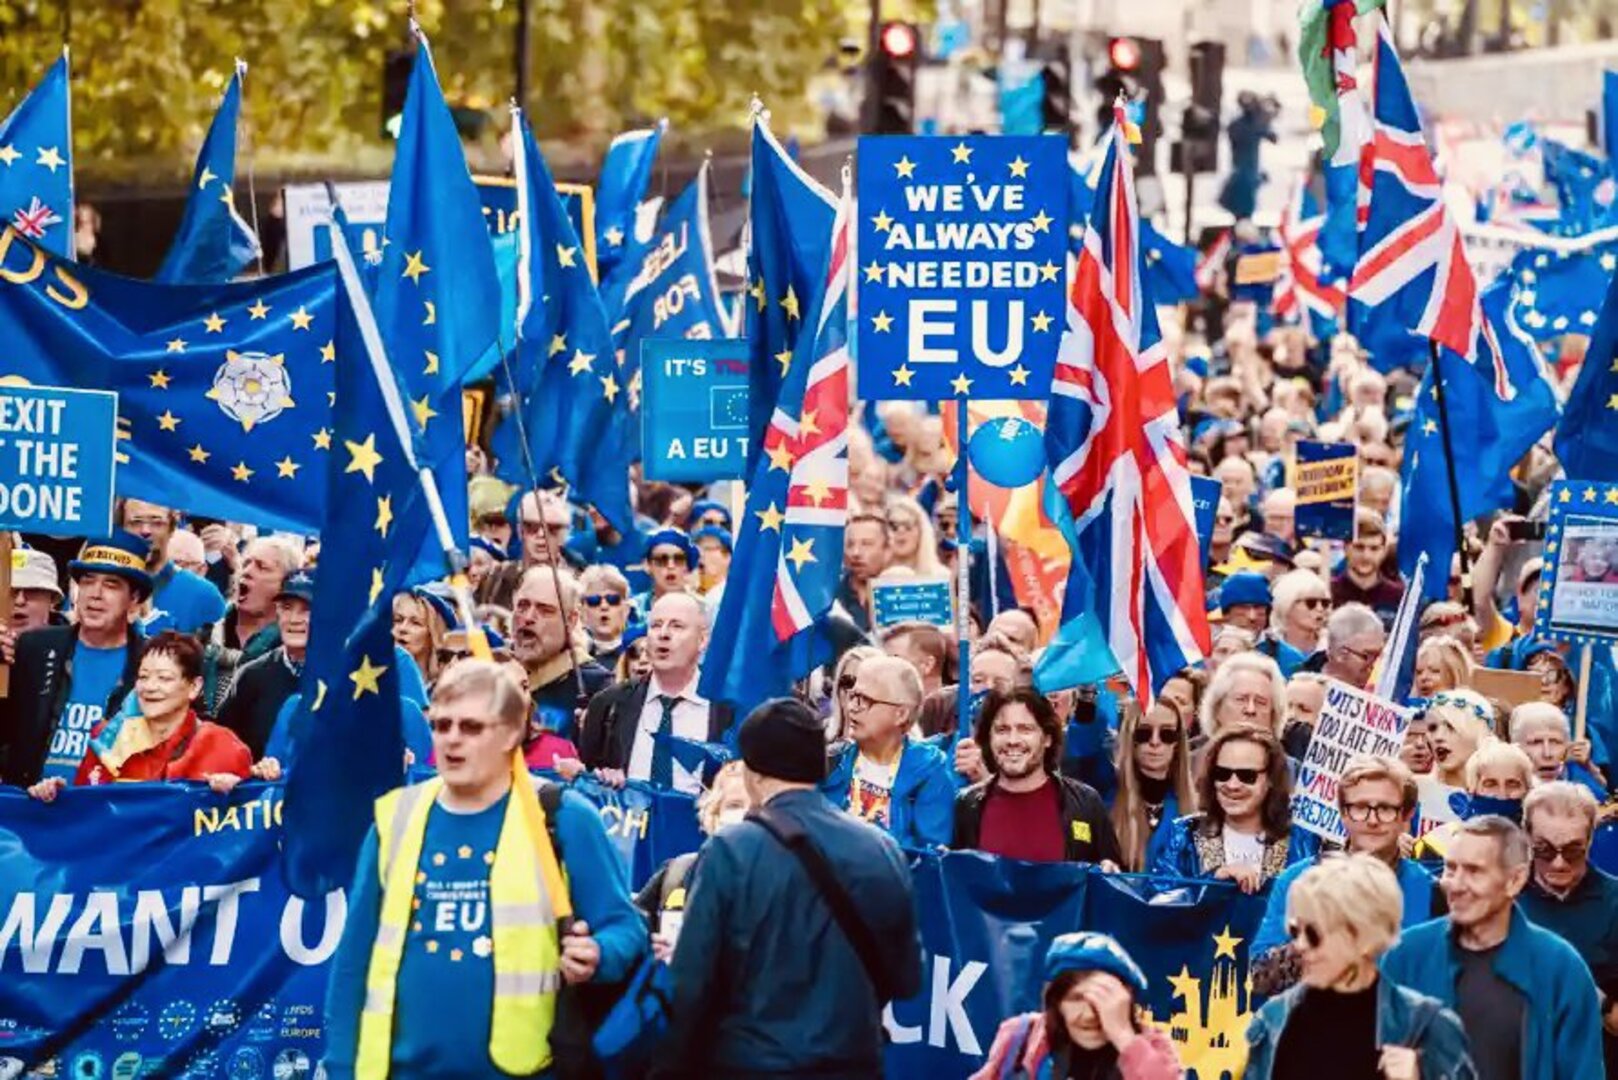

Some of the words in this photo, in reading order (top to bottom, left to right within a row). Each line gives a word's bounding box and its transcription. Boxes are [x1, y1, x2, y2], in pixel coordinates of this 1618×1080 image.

[905, 172, 1025, 212] WE'VE
[884, 223, 1036, 250] ALWAYS
[888, 261, 1039, 288] NEEDED
[908, 300, 1025, 368] EU
[664, 359, 707, 377] IT'S
[15, 440, 79, 479] THE
[667, 438, 686, 459] A
[693, 438, 728, 459] EU
[1317, 712, 1341, 740] TOO
[1338, 721, 1372, 754] LATE
[1307, 741, 1352, 774] ADMIT
[0, 876, 260, 976] WANT
[435, 901, 486, 932] EU
